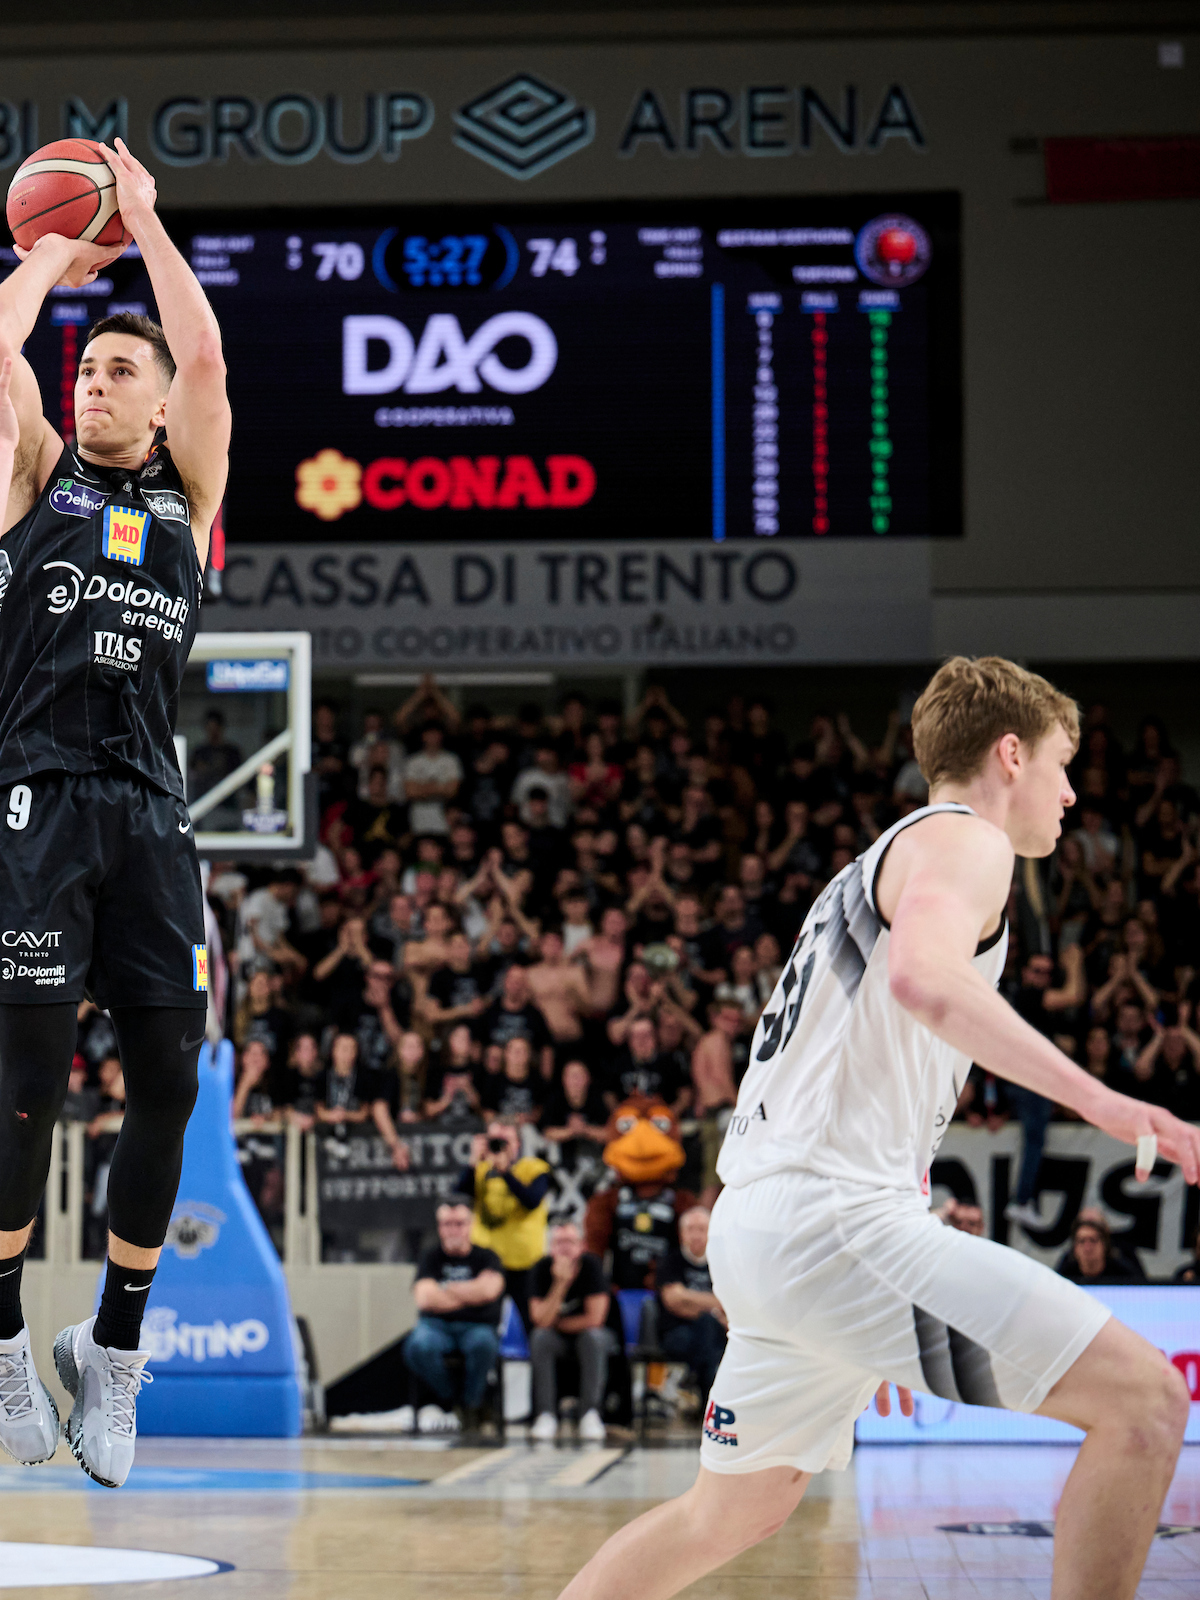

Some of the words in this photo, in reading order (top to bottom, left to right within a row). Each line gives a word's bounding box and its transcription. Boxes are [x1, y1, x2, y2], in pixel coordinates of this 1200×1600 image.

[149, 92, 436, 166] GROUP
[617, 82, 928, 157] ARENA
[312, 241, 365, 281] 70
[526, 236, 581, 278] 74
[341, 310, 559, 395] DAO
[361, 454, 598, 509] CONAD
[111, 522, 140, 545] MD
[83, 575, 190, 625] Dolomiti
[220, 554, 428, 606] CASSA
[452, 555, 518, 605] DI
[536, 551, 798, 605] TRENTO
[93, 630, 143, 663] ITAS
[122, 609, 183, 643] energia
[371, 623, 621, 657] COOPERATIVO
[631, 622, 797, 656] ITALIANO
[6, 784, 33, 831] 9
[1, 930, 63, 949] CAVIT
[17, 964, 66, 978] Dolomiti
[34, 974, 66, 987] energia
[142, 1310, 270, 1363] ENTINO
